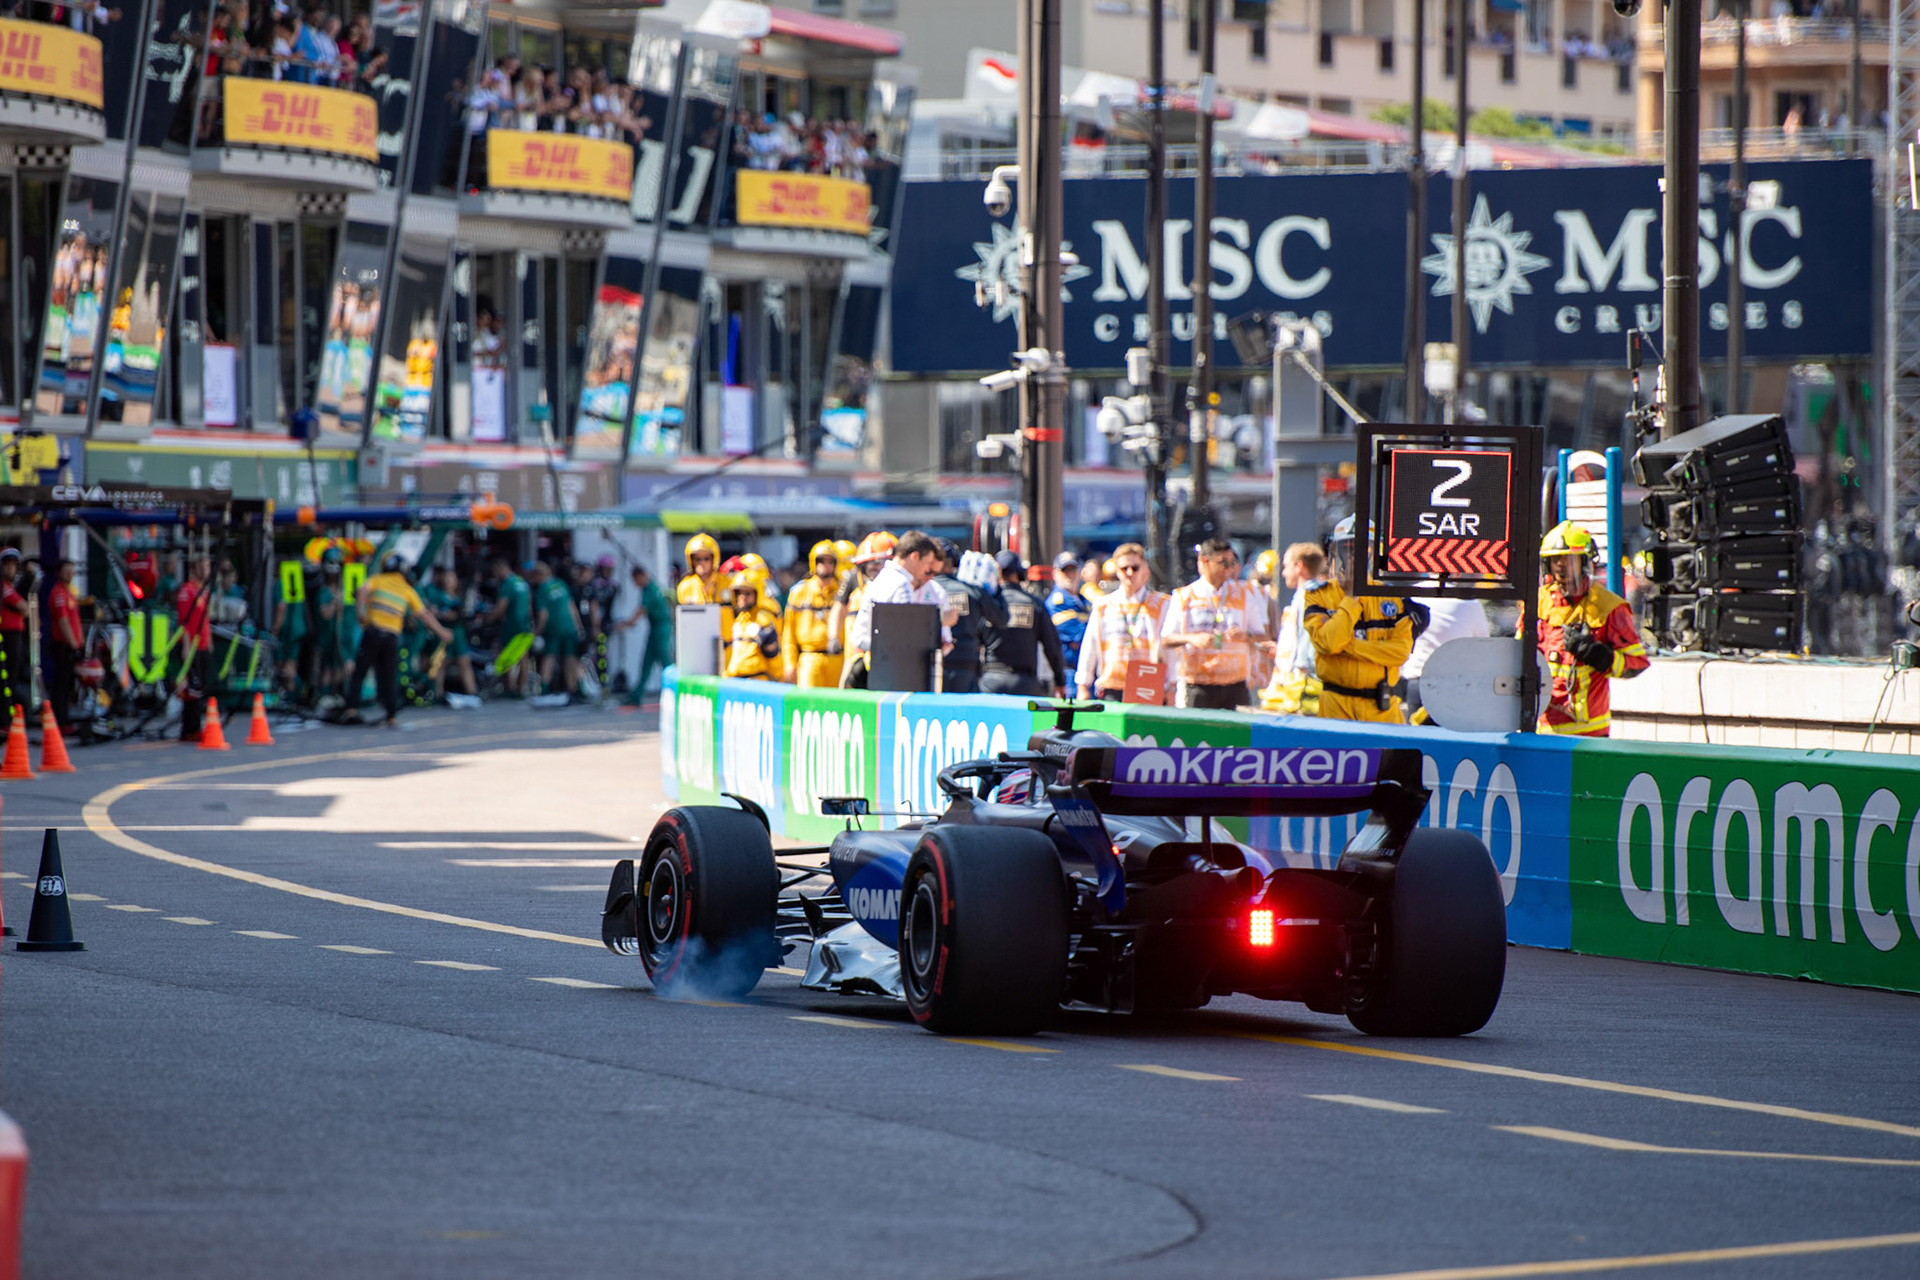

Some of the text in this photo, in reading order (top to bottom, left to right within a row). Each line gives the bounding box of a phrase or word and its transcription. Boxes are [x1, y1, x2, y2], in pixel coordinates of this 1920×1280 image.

[0, 30, 44, 80] HL
[261, 91, 322, 136] DHL
[524, 142, 580, 180] DHL
[1092, 215, 1332, 301] MSC
[1094, 310, 1333, 342] CRUIS
[1554, 300, 1803, 334] CRUSES
[1430, 460, 1473, 507] 2
[1418, 512, 1481, 535] SAR
[41, 881, 62, 891] FIA
